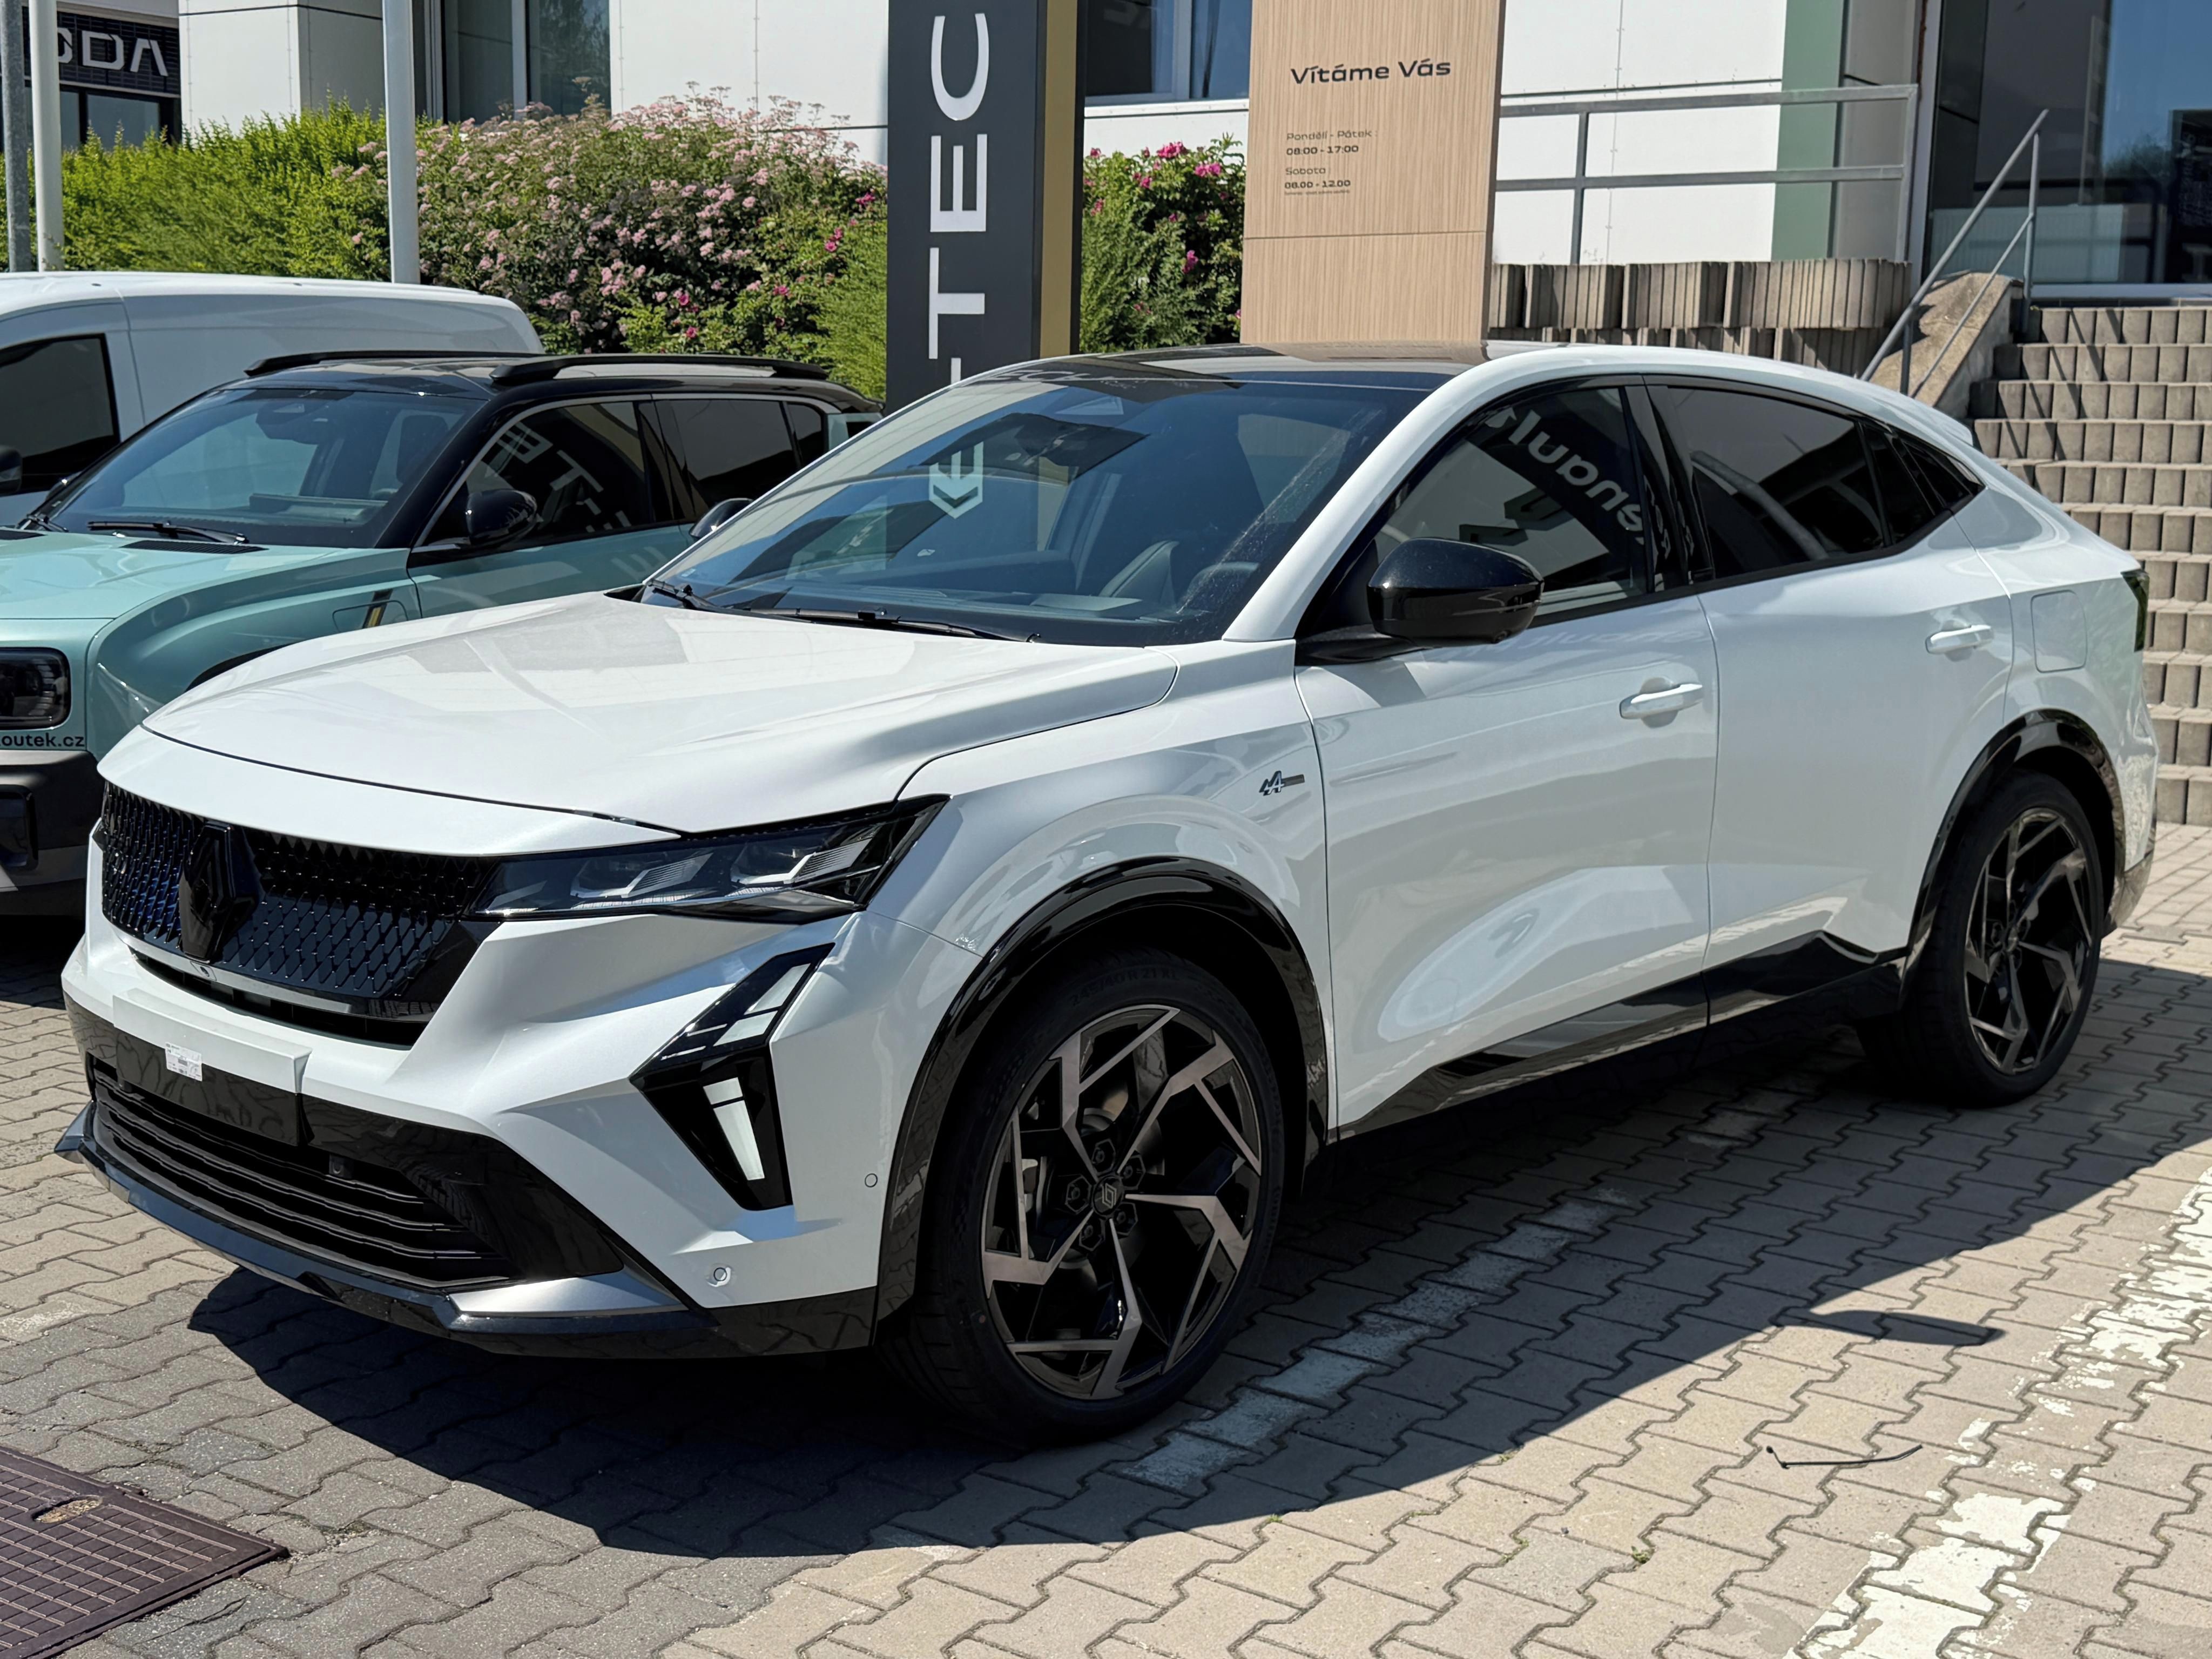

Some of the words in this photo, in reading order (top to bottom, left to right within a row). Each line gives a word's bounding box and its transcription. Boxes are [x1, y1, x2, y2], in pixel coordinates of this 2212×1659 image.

[1291, 64, 1390, 84] Vítáme
[1398, 58, 1451, 78] Vás
[1286, 130, 1328, 141] Pondělí
[1327, 145, 1359, 154] 17:00
[0, 732, 85, 747] outek.cz
